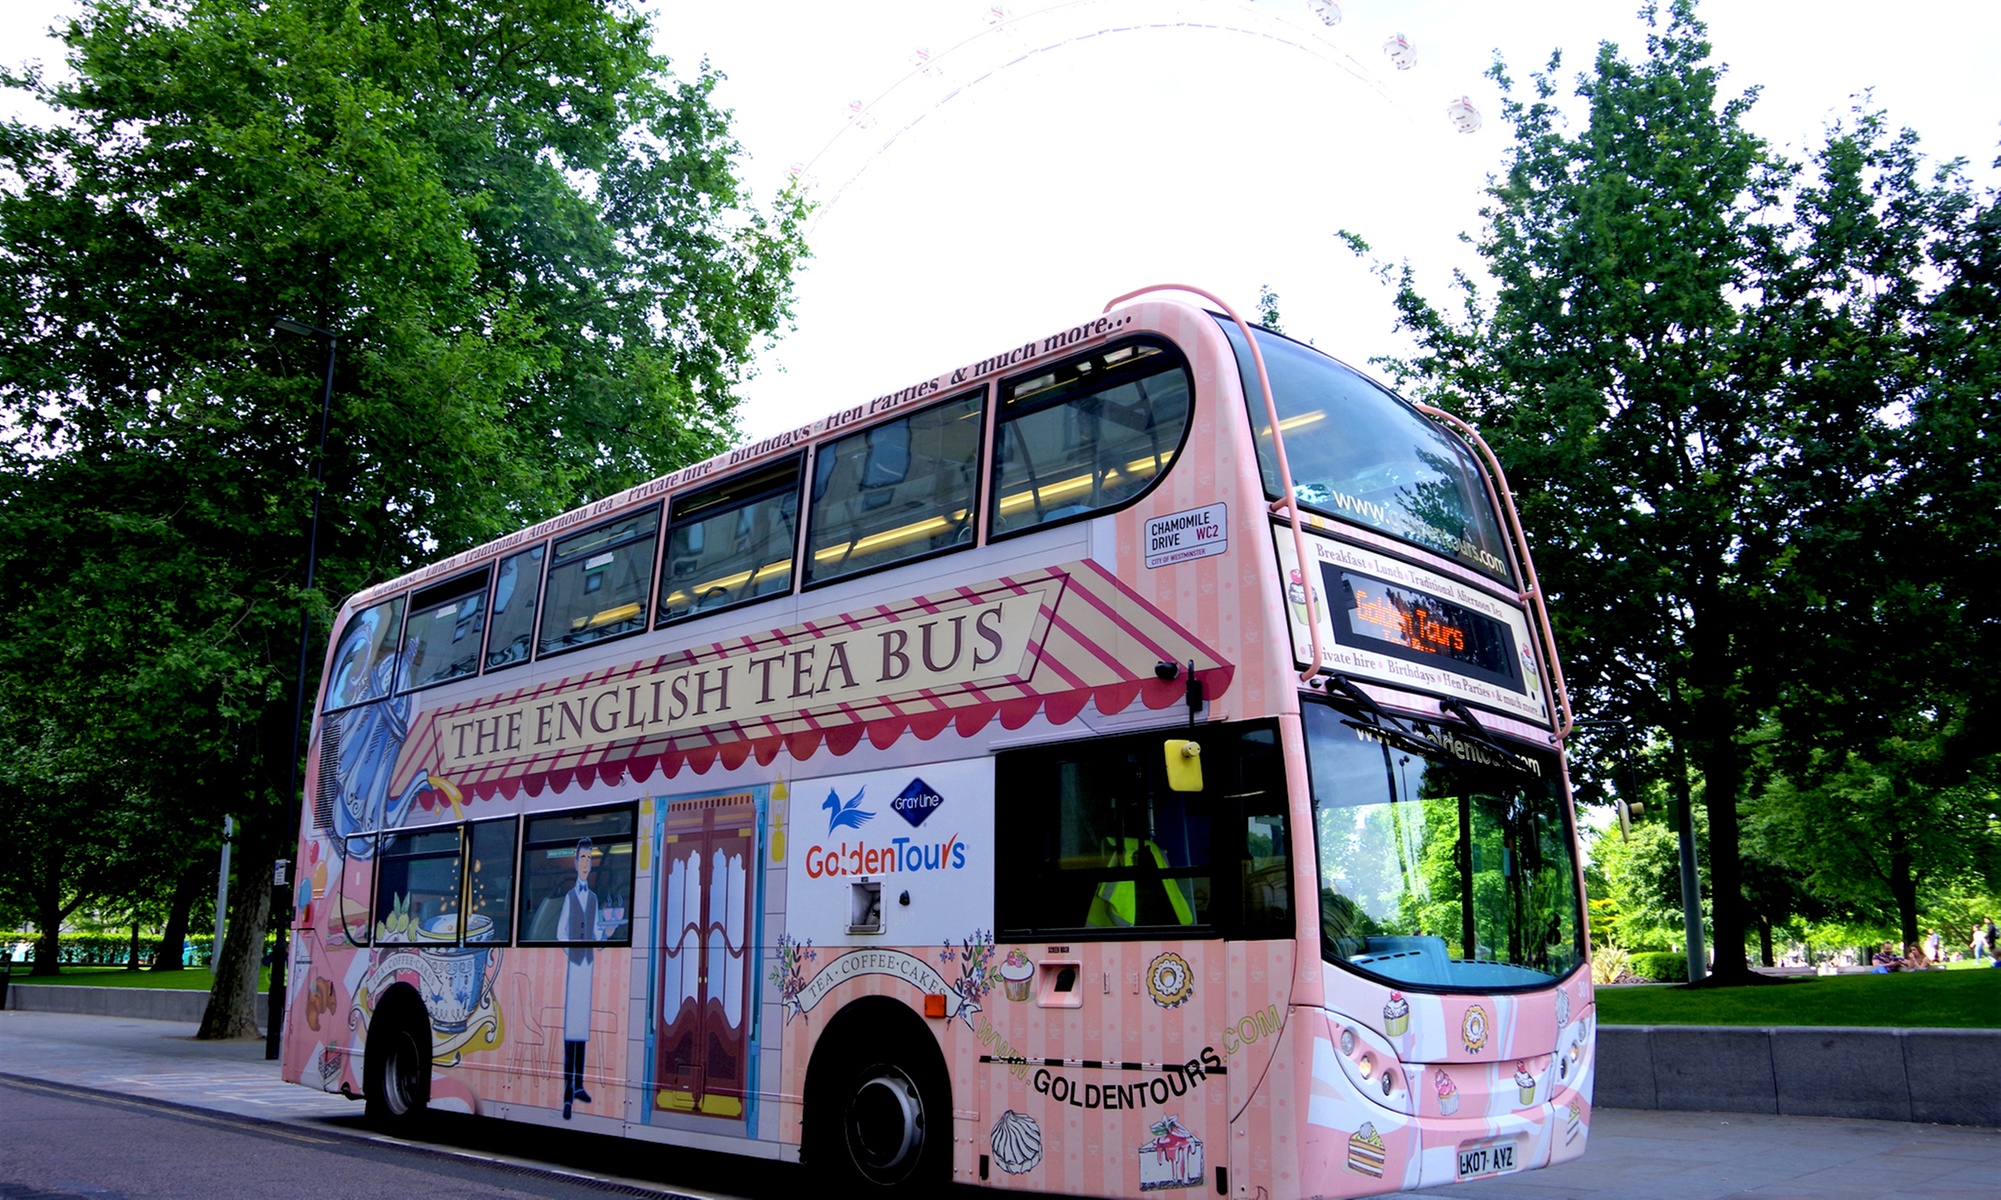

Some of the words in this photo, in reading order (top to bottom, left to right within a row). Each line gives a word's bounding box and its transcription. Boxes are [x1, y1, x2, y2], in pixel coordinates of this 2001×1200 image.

[527, 508, 588, 540] Afternoon
[592, 499, 614, 515] Tea
[628, 473, 679, 502] Private
[682, 459, 713, 482] hire
[729, 424, 811, 465] Birthdays
[825, 405, 863, 430] Hen
[869, 376, 940, 415] Parties
[951, 366, 968, 385] &
[974, 341, 1037, 377] much
[1044, 316, 1132, 352] more...
[1151, 511, 1210, 536] CHAMOMILE
[1151, 533, 1180, 551] DRIVE
[1196, 524, 1219, 540] WC2
[1163, 554, 1170, 563] OF
[1171, 548, 1206, 561] WESTMINSTER
[1315, 543, 1367, 569] Breakfast
[1374, 559, 1405, 580] Lunch
[1408, 570, 1455, 598] Traditional
[1457, 589, 1492, 613] Afternoon
[1490, 602, 1504, 618] Tea
[1415, 608, 1465, 651] Tours
[451, 711, 523, 763] THE
[534, 664, 733, 746] ENGLISH
[748, 638, 860, 706] TEA
[876, 601, 1004, 683] BUS
[1308, 644, 1351, 665] Pivate
[1353, 652, 1377, 670] hire
[1386, 659, 1436, 685] Birthdays
[1442, 673, 1463, 689] Hen
[1462, 678, 1491, 699] Parties
[1495, 689, 1502, 702] &
[1504, 695, 1522, 710] much
[388, 955, 415, 969] COFFEE
[415, 960, 435, 986] CAKES
[808, 971, 837, 999] TEA
[841, 953, 896, 975] COFFEE
[900, 960, 947, 996] CAKES
[1493, 1146, 1514, 1170] AYZ
